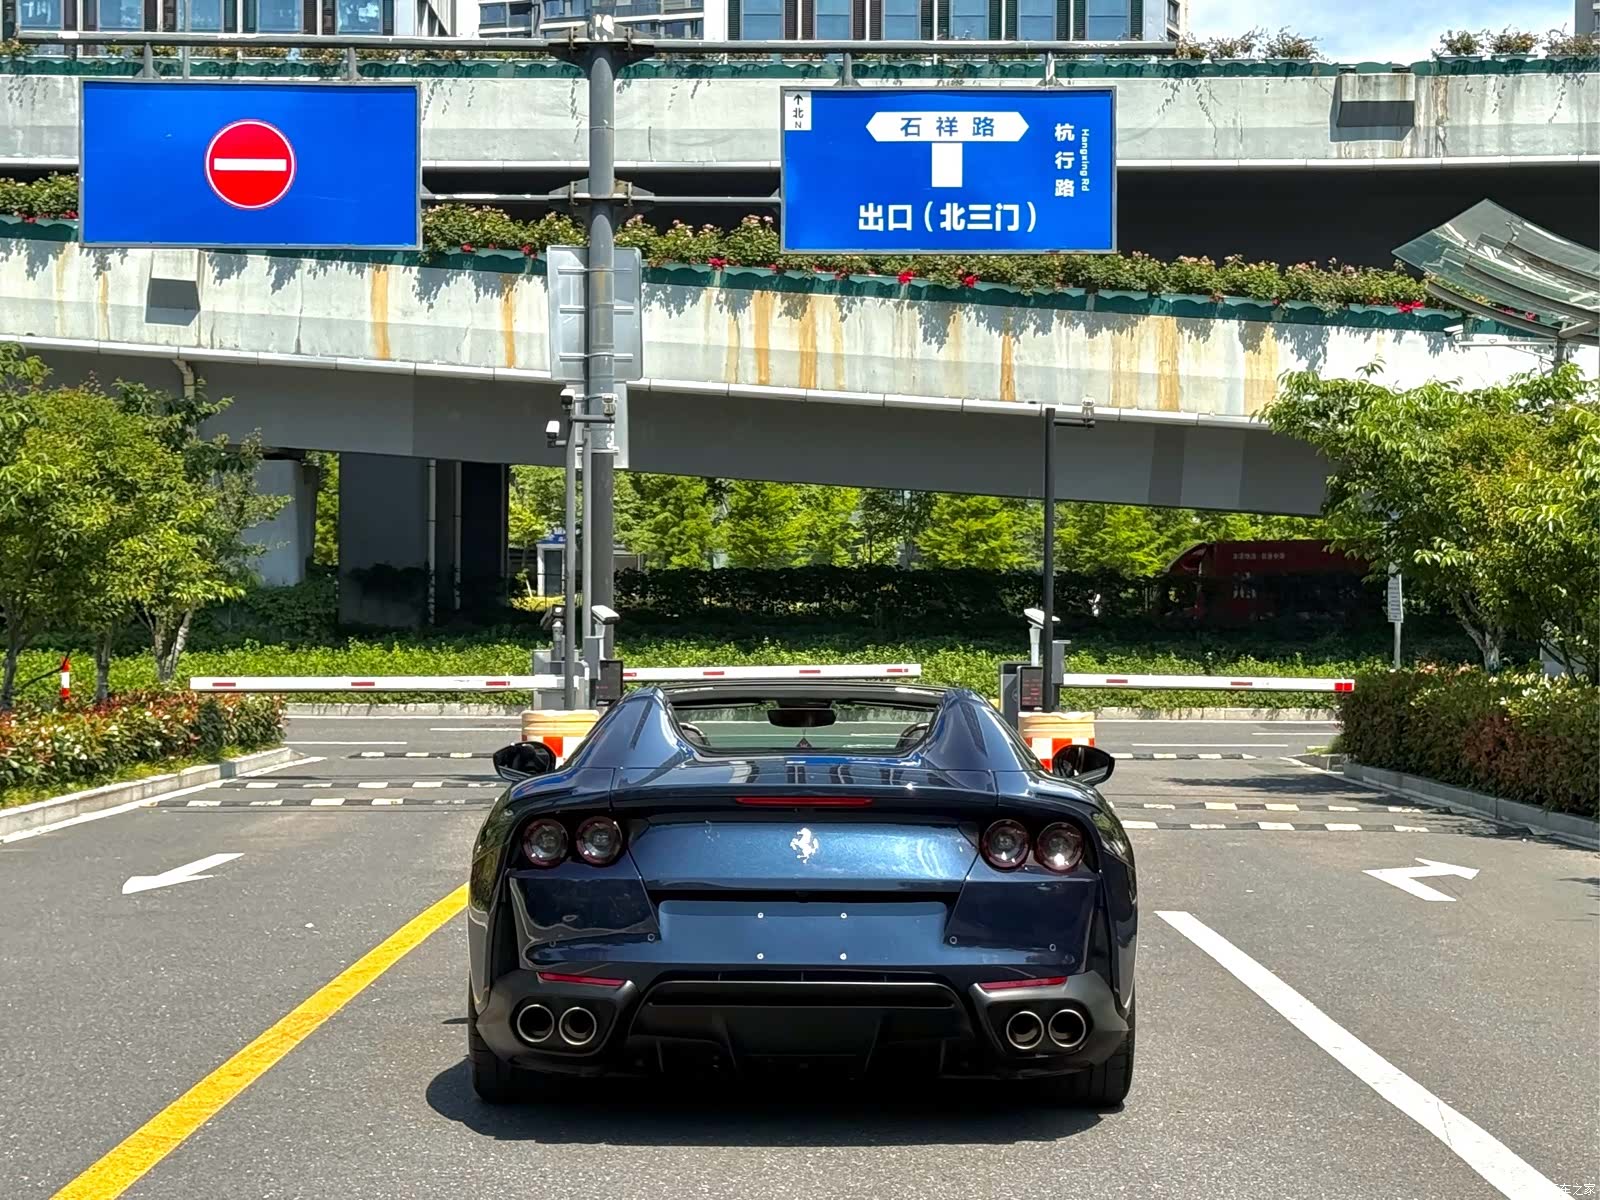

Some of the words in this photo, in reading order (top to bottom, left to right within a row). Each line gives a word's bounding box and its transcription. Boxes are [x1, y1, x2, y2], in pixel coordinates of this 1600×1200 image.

[792, 107, 804, 119] 北
[794, 121, 802, 129] N
[900, 116, 995, 138] 石祥路
[1054, 123, 1075, 198] 杭行路
[1079, 128, 1090, 176] Hangxing
[1080, 178, 1090, 192] Rd
[858, 201, 1037, 233] 出口（北三门）
